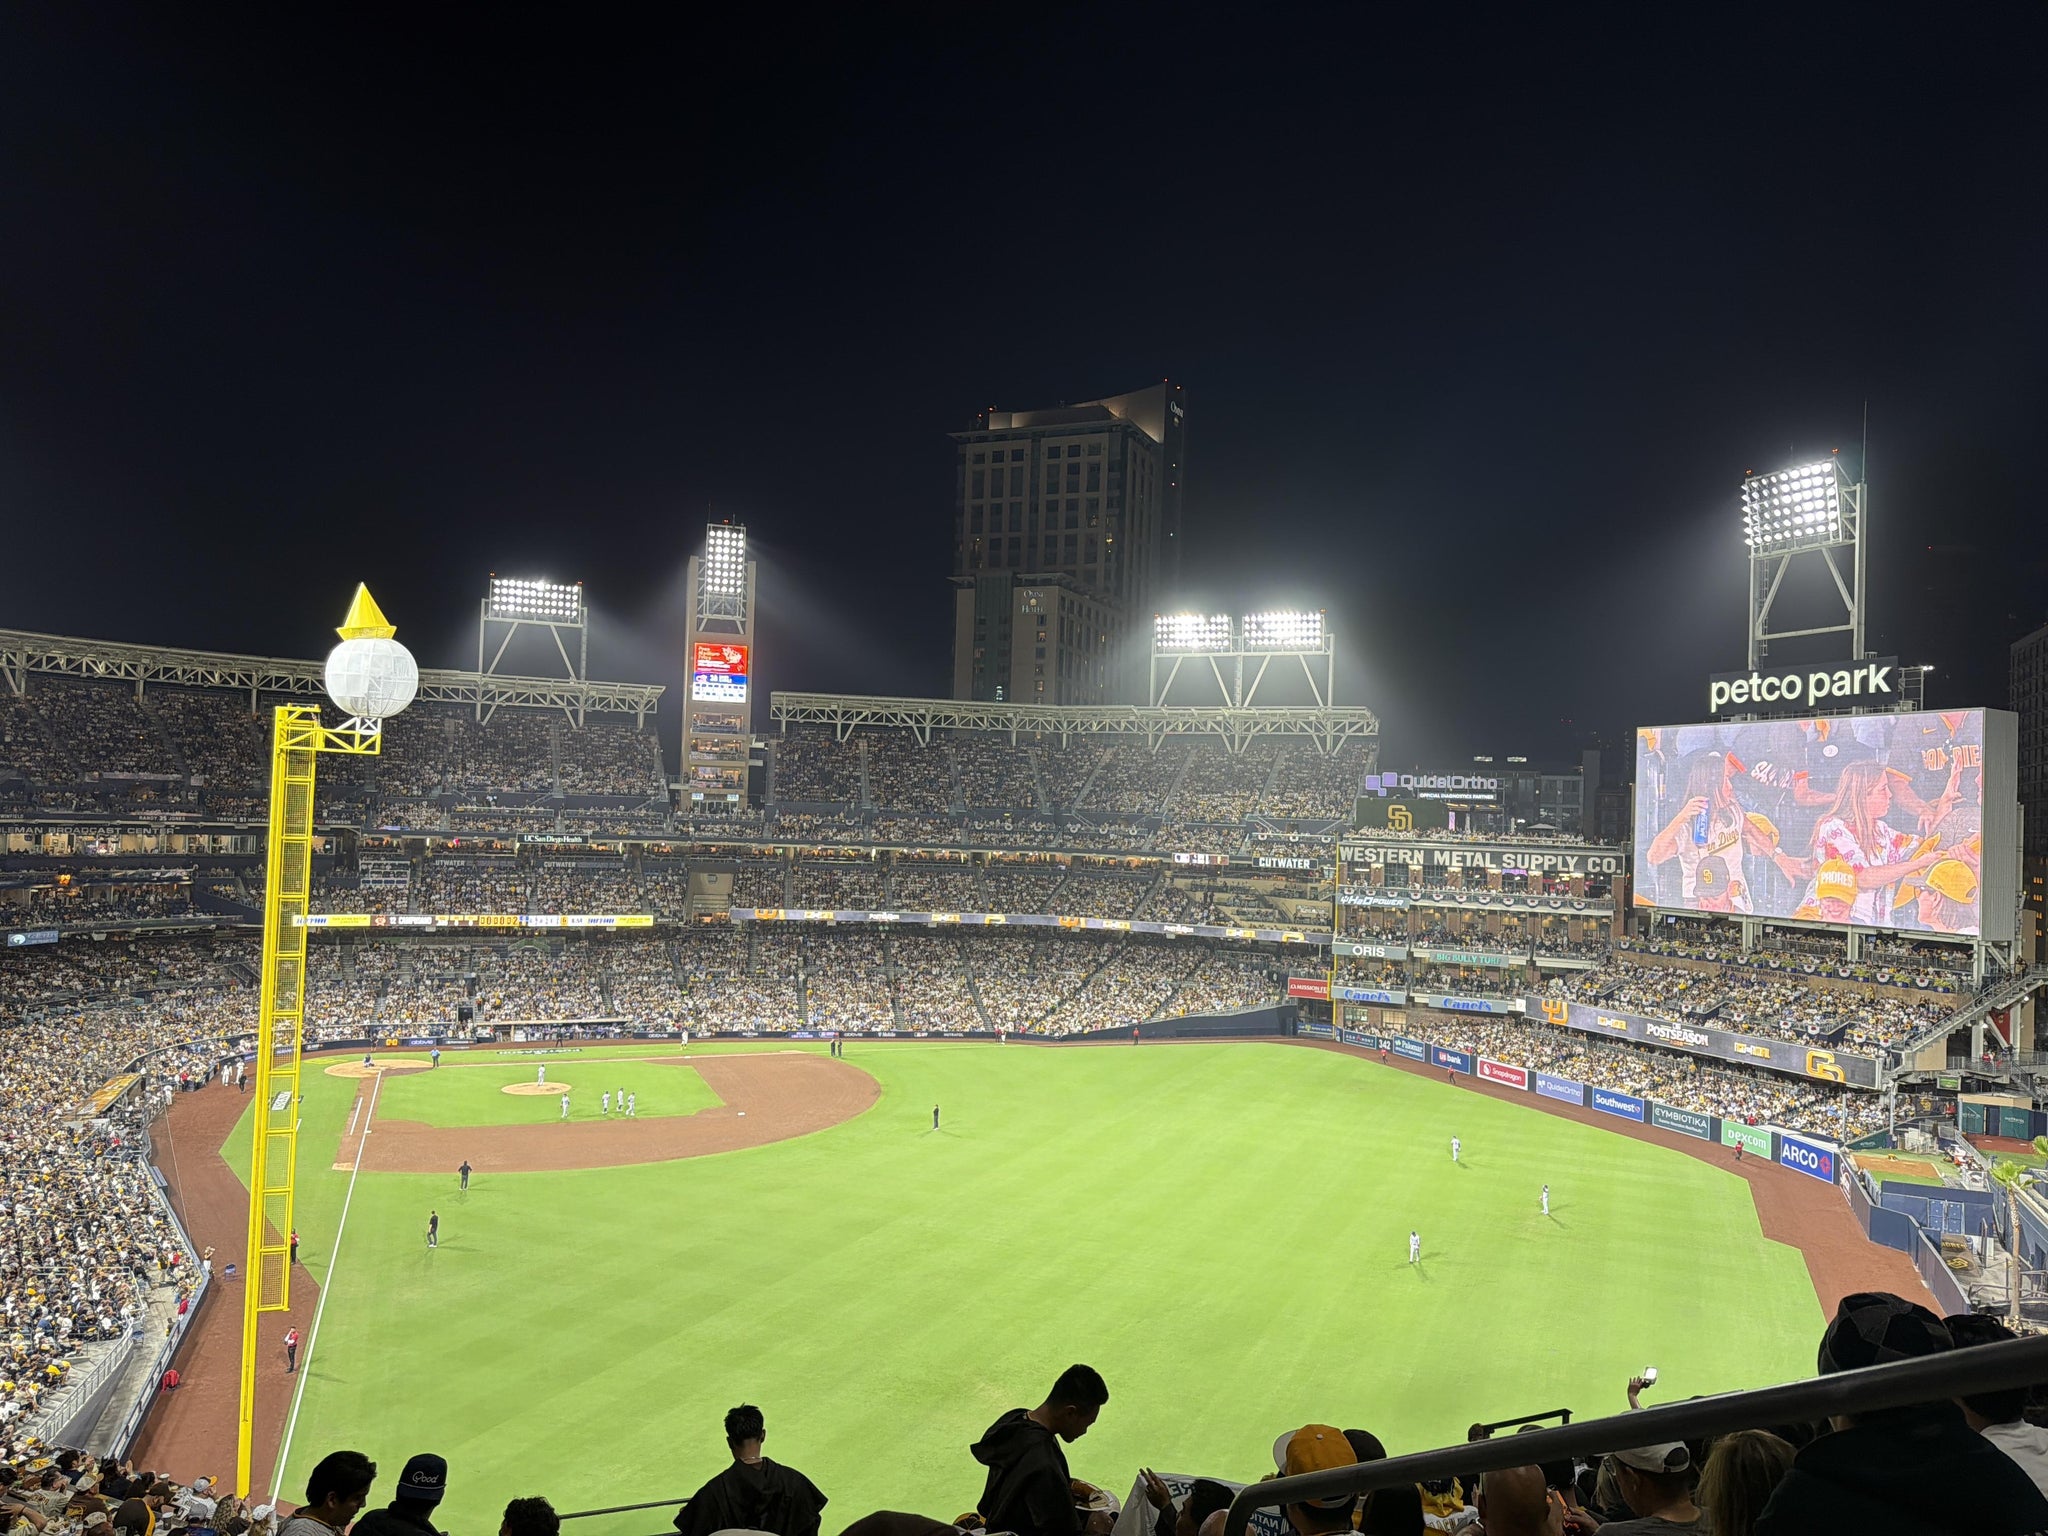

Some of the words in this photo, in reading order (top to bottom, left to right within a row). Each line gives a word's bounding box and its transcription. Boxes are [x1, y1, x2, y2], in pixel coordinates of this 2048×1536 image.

[1711, 672, 1802, 713] petco
[1809, 663, 1892, 706] park
[1400, 774, 1498, 790] QuidelOrtho
[1259, 856, 1310, 869] CUTWATER
[1340, 846, 1424, 865] WESTERN
[1433, 850, 1496, 869] METAL
[1502, 853, 1578, 872] SUPPLY
[1587, 857, 1622, 874] CO.
[1352, 945, 1385, 957] ORIS
[1437, 953, 1451, 961] BIG
[1453, 954, 1477, 964] BULLY
[411, 1038, 434, 1046] abbvie
[1646, 1023, 1709, 1046] POSTSEASON
[1378, 1040, 1391, 1050] 342
[1492, 1067, 1522, 1083] Snapdragon
[1546, 1081, 1581, 1097] QuidelOrtho
[1595, 1093, 1635, 1113] Southwest
[1654, 1107, 1708, 1129] CYMBIOTIKA
[1782, 1143, 1818, 1170] ARCO
[412, 1471, 439, 1484] Good
